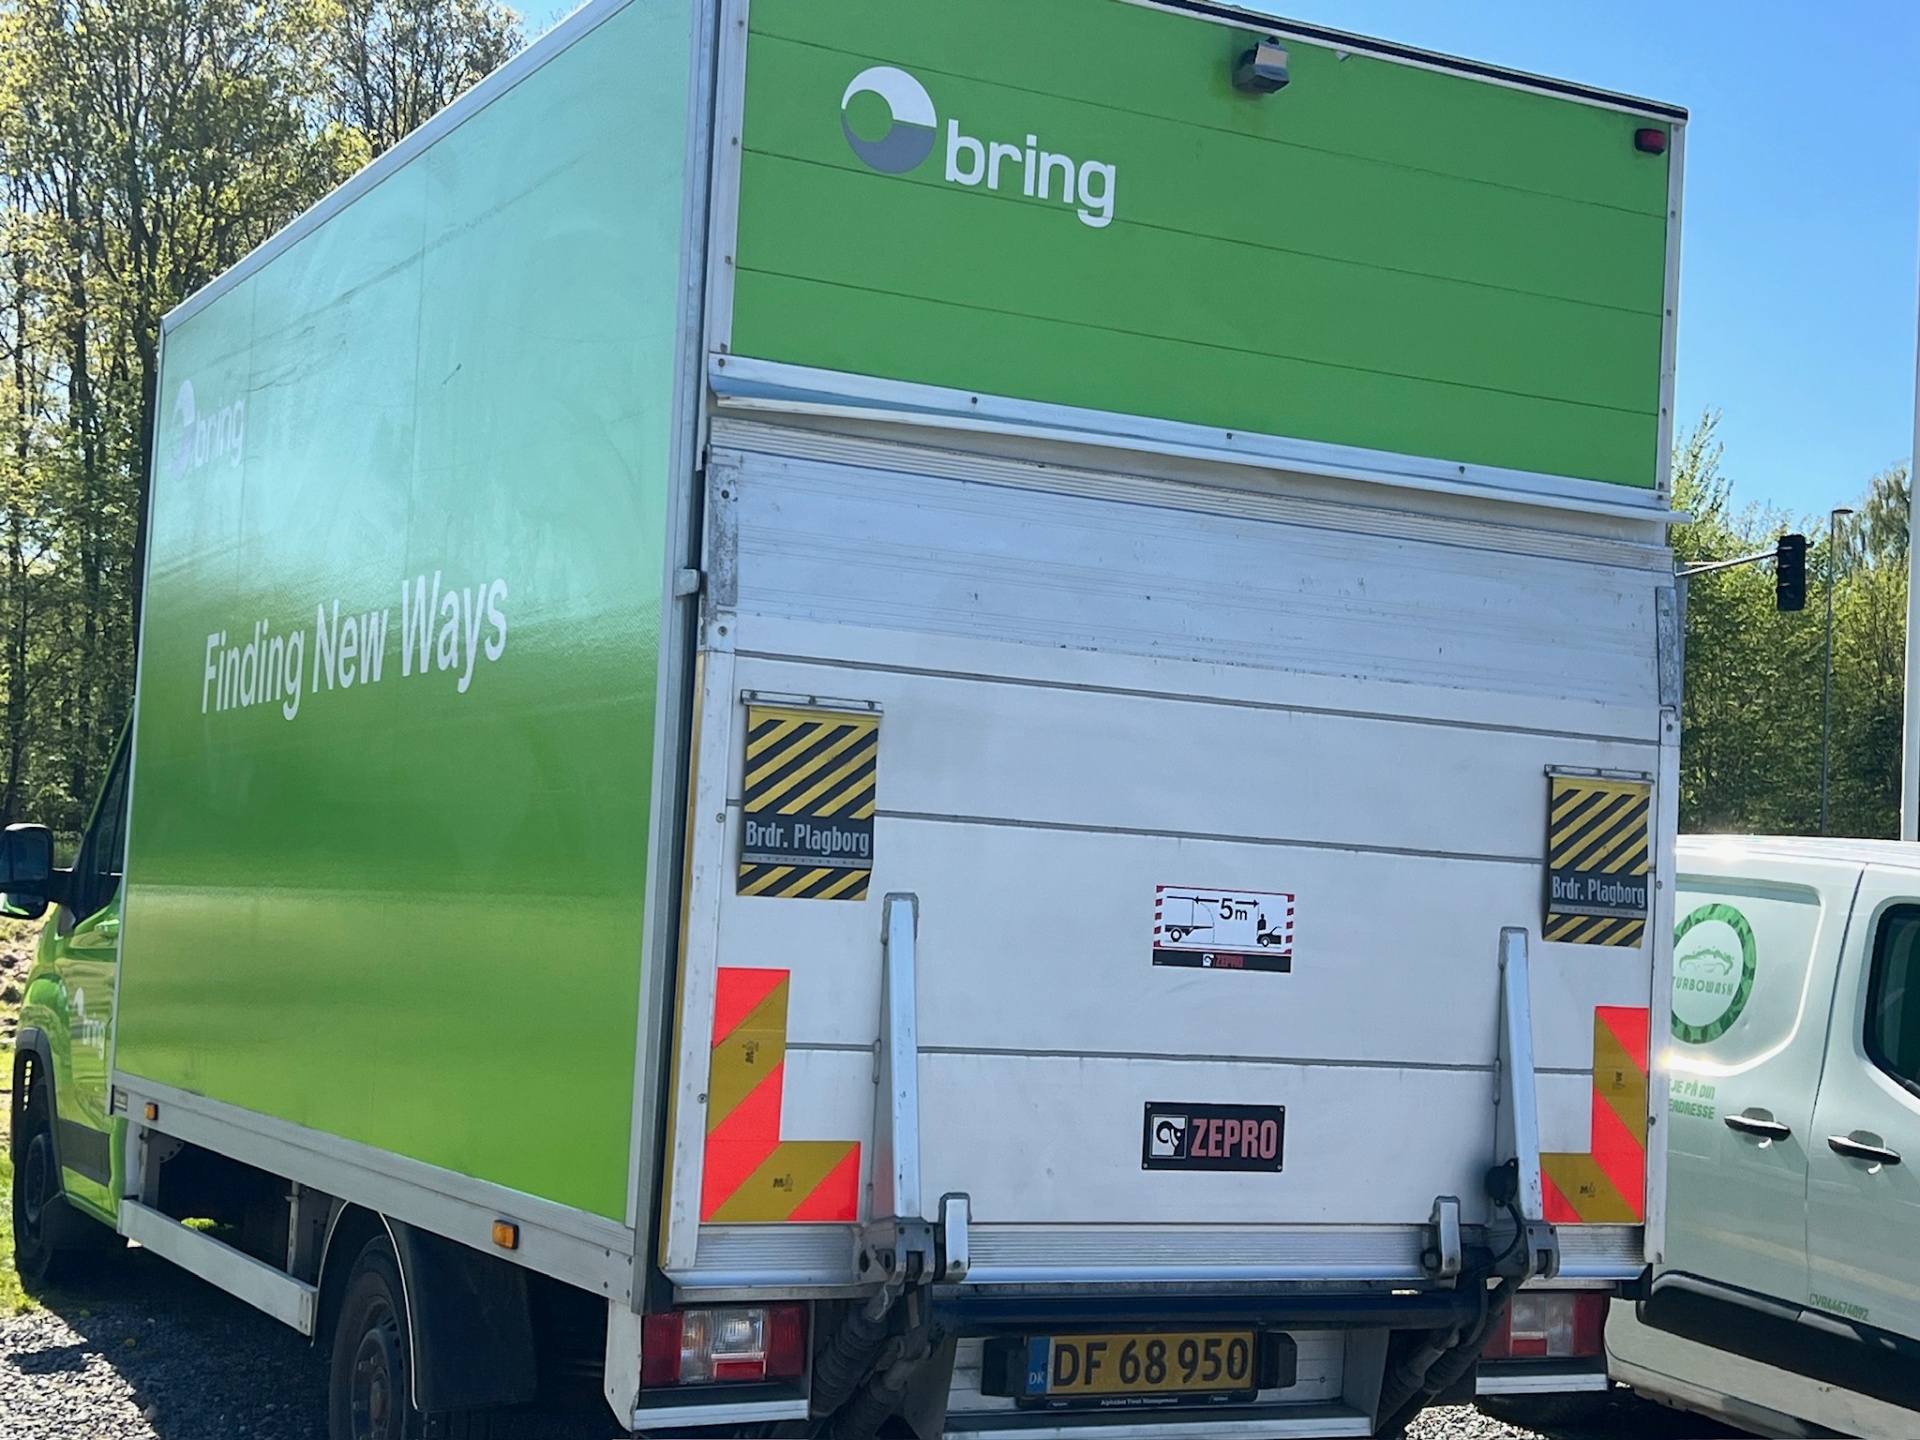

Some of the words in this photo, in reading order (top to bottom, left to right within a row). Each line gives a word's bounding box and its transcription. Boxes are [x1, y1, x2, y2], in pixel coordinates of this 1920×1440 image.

[945, 118, 1116, 228] bring
[194, 398, 246, 469] bring
[202, 618, 305, 721] Finding
[312, 599, 390, 694] New
[402, 570, 508, 694] Ways
[745, 821, 789, 849] Brdr.
[793, 823, 870, 856] Plagborg
[1552, 876, 1584, 900] Brdr.
[1588, 878, 1646, 909] Plagborg
[1215, 954, 1244, 968] ZEPRO
[1190, 1118, 1278, 1160] ZEPRO
[1029, 1371, 1046, 1386] DK
[1053, 1342, 1107, 1387] DF
[1119, 1338, 1168, 1385] 68
[1177, 1336, 1250, 1384] 950
